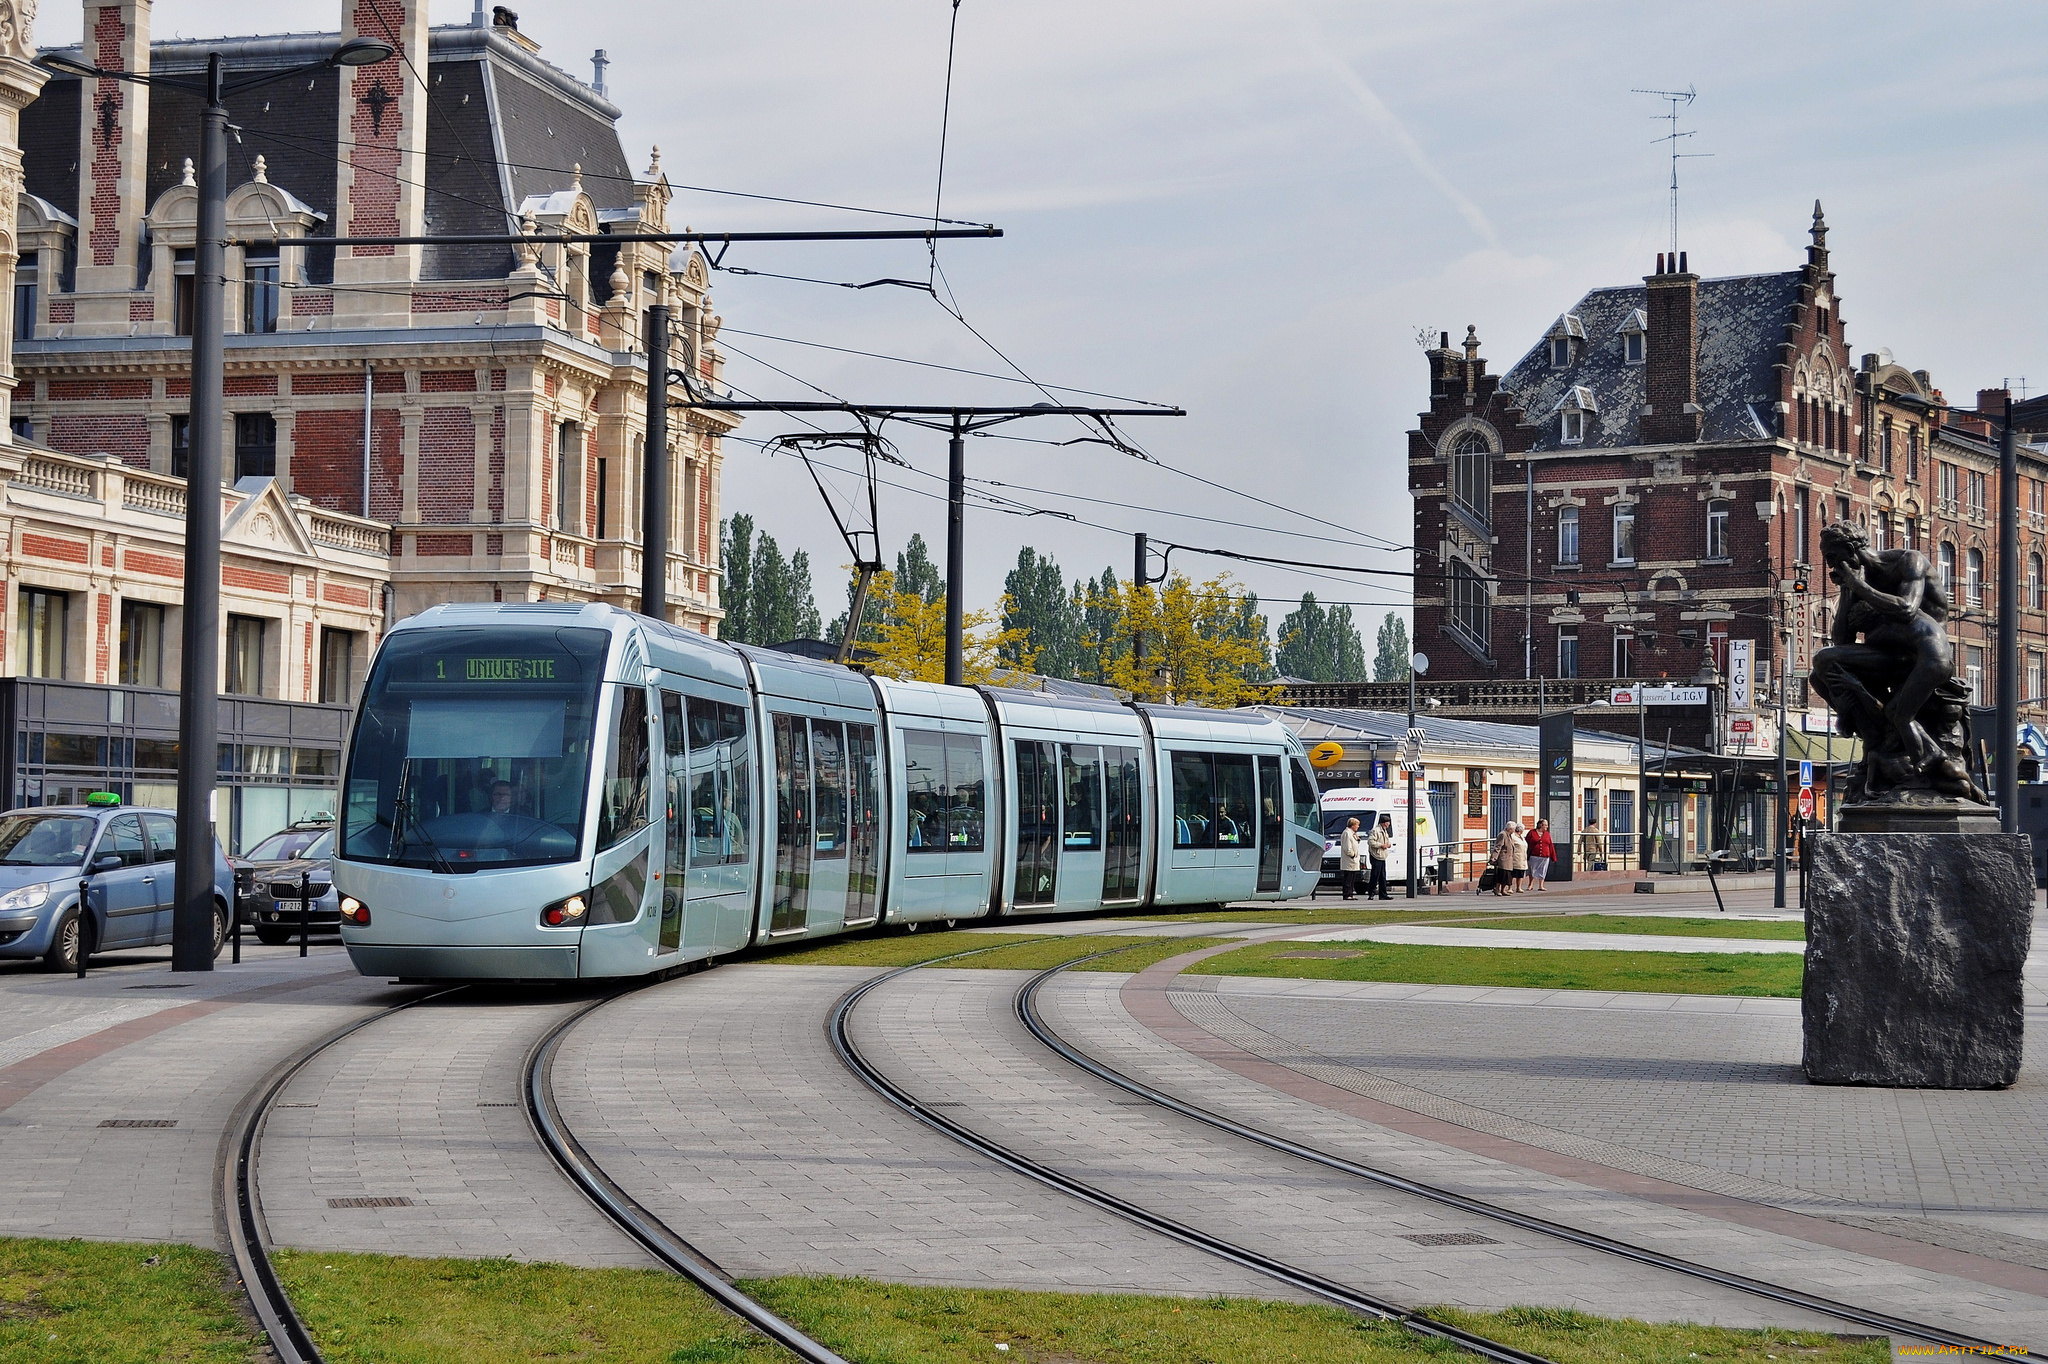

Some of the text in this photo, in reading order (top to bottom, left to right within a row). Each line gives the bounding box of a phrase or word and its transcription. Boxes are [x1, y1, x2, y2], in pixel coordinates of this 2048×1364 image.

[1796, 594, 1805, 663] MAMOUNIA
[1733, 641, 1747, 651] Le
[437, 658, 555, 679] 1 UNIVERSITE
[1671, 692, 1681, 701] Le
[1683, 691, 1704, 701] T.G.V
[1800, 798, 1812, 808] STOP
